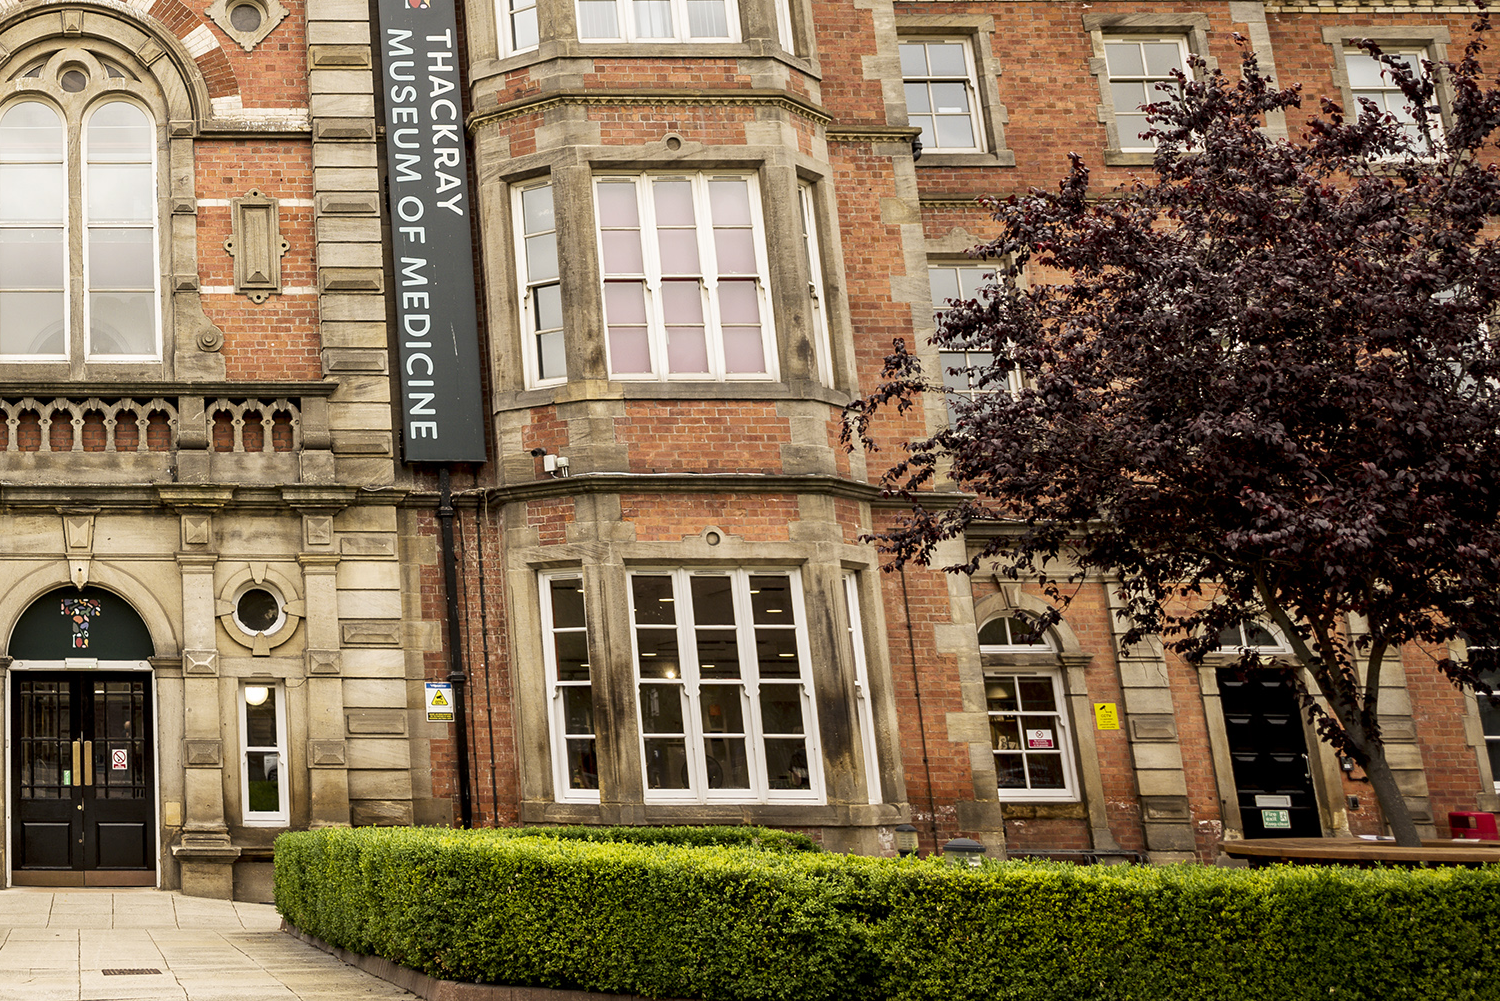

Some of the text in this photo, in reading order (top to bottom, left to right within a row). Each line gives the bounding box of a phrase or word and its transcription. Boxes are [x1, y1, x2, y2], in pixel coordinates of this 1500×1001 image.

[386, 28, 439, 441] MUSEUM OF MEDICINE
[426, 28, 464, 217] THACKRAY
